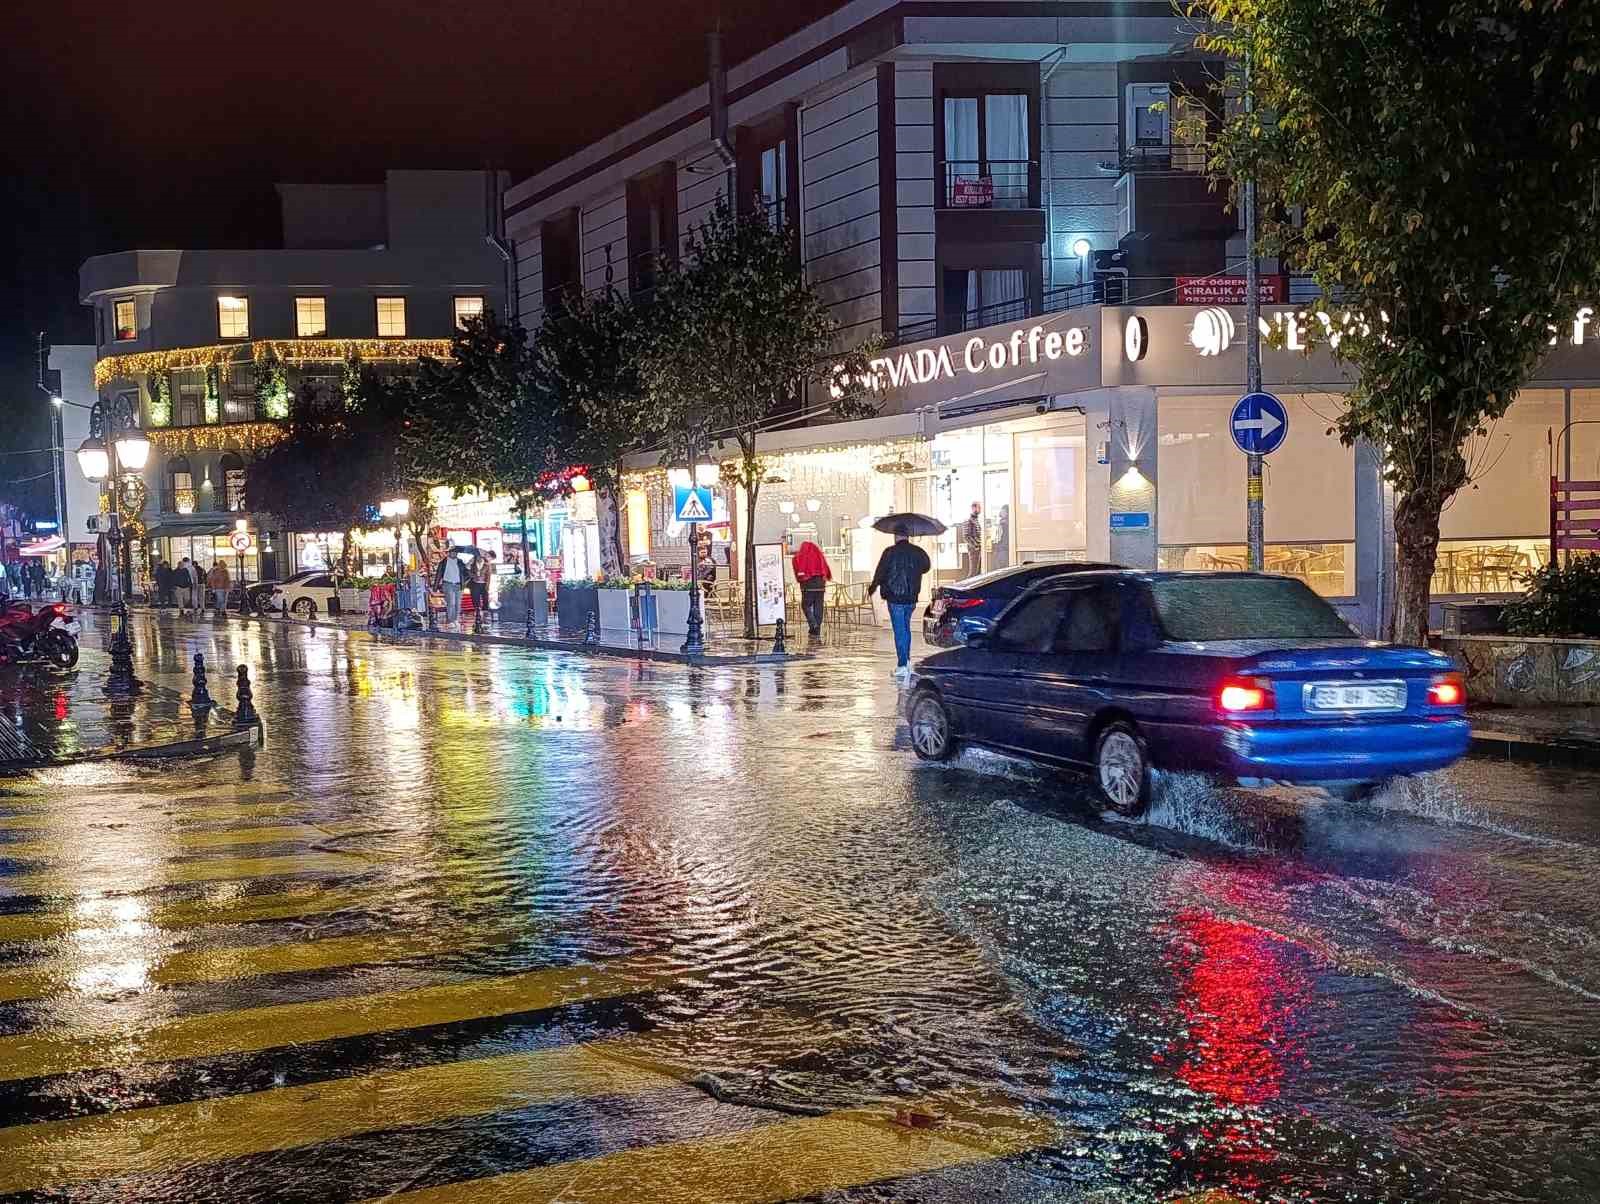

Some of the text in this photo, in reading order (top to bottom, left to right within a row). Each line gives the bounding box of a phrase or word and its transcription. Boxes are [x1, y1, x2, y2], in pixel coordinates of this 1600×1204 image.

[1183, 286, 1276, 295] KİRALIK ART
[964, 325, 1085, 373] Coffee
